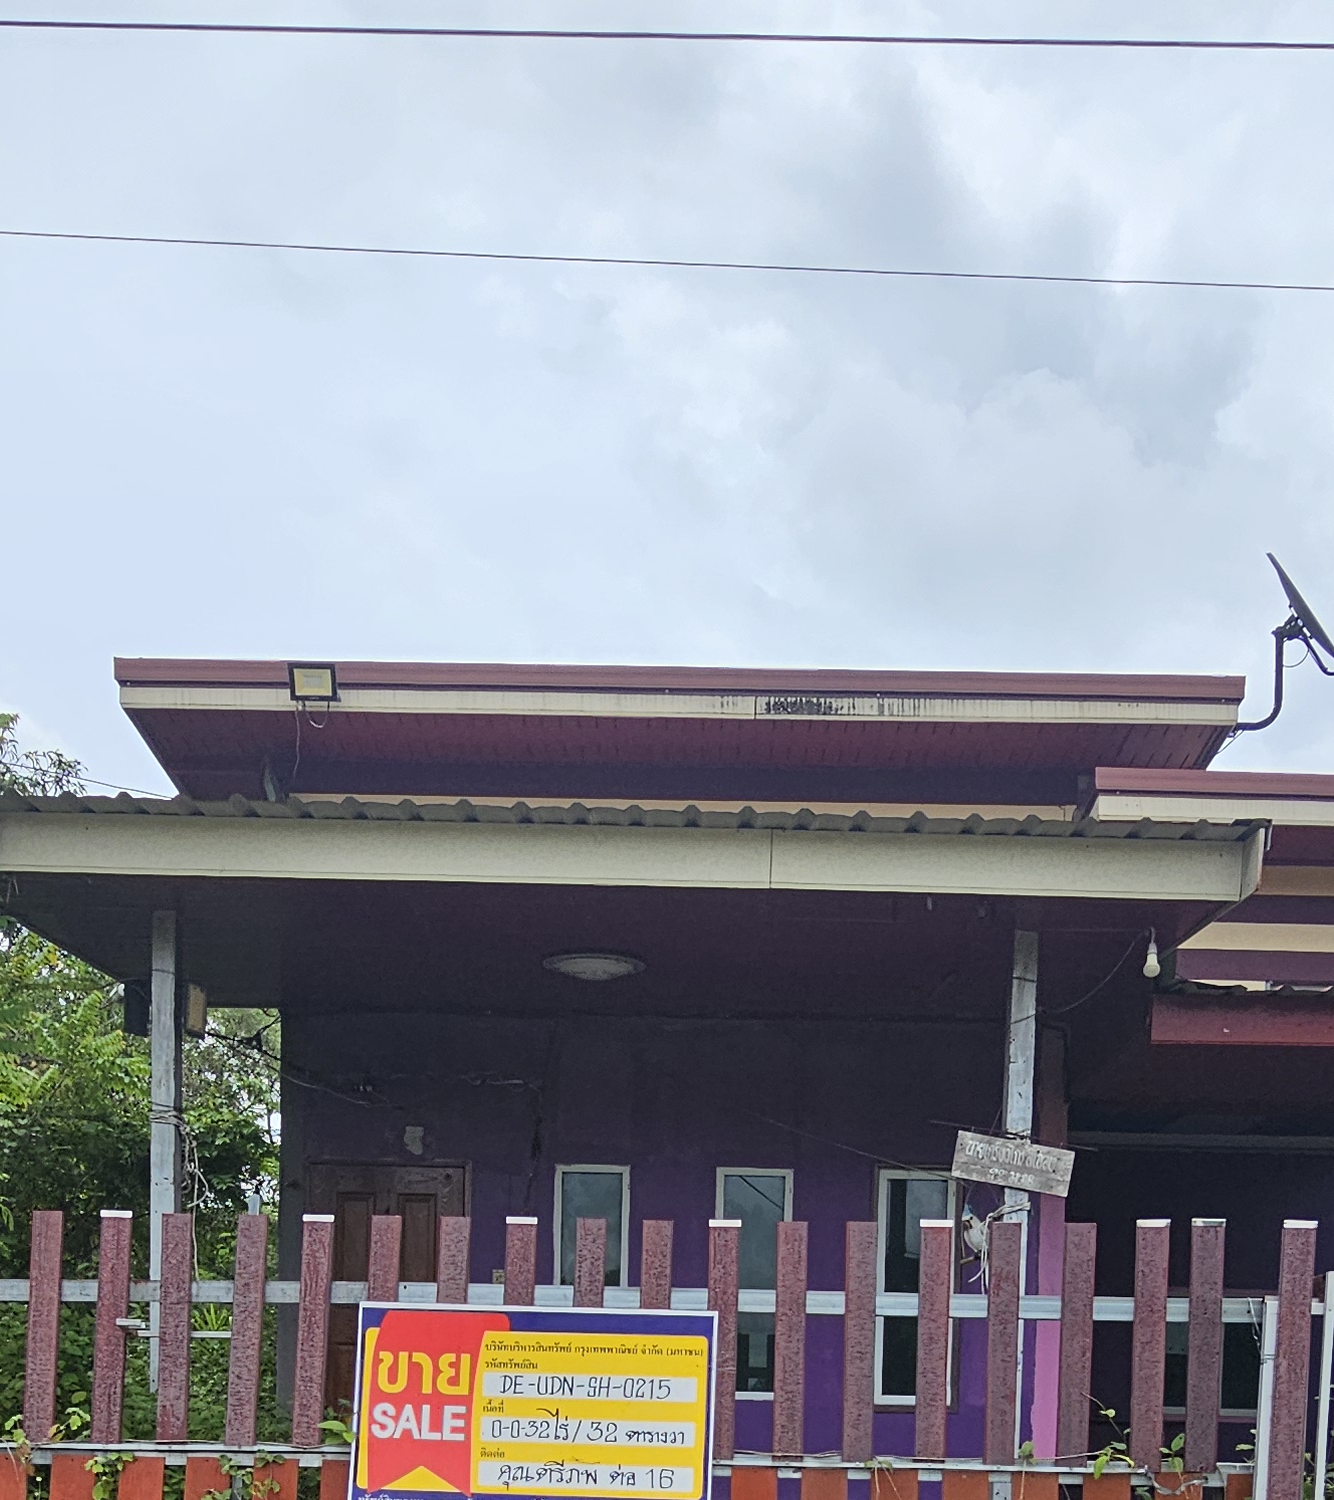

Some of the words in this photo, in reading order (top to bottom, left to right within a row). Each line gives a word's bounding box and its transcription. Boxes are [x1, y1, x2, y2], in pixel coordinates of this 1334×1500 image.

[641, 1344, 663, 1356] จำกัด
[666, 1348, 704, 1357] (มหาชน)
[485, 1358, 538, 1370] รหัสทรัพย์สิน
[377, 1351, 471, 1395] ขาย
[482, 1399, 504, 1413] เนื้อที่
[370, 1402, 467, 1441] SALE
[480, 1447, 505, 1458] ติดต่อ
[609, 1464, 636, 1486] ต่อ
[645, 1468, 675, 1489] 16
